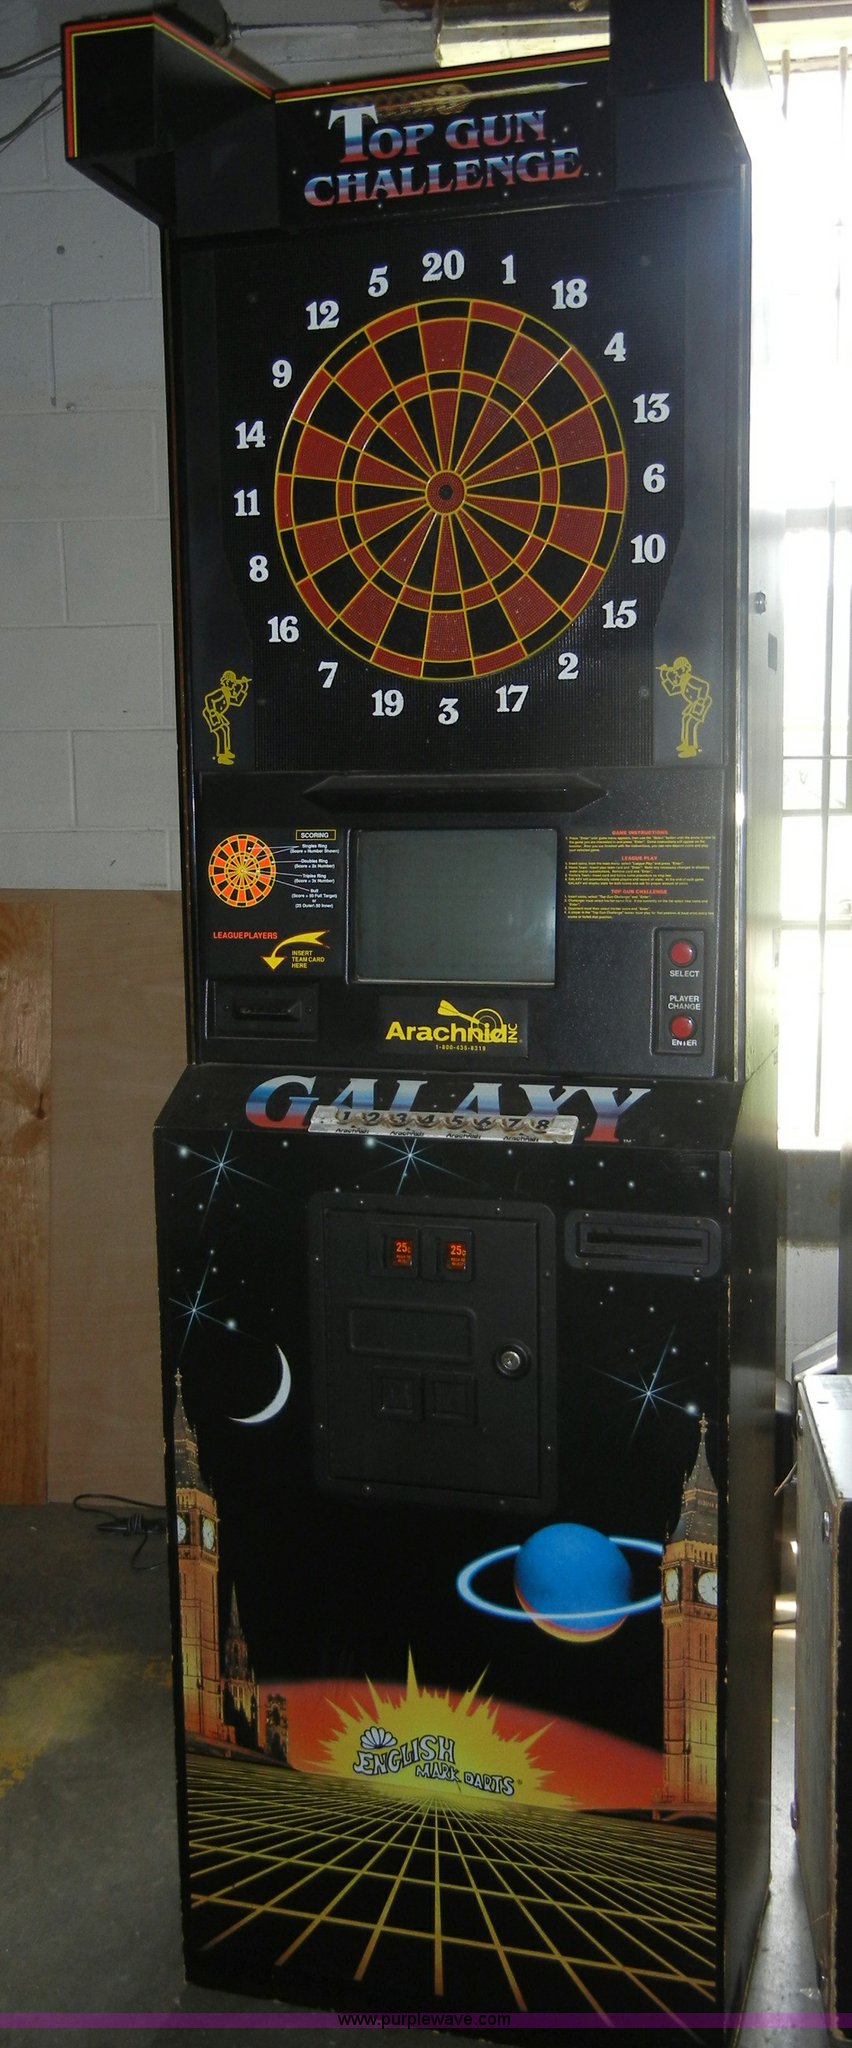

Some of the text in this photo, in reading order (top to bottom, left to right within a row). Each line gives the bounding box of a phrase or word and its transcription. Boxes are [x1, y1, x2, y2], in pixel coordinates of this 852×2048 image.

[328, 104, 546, 164] TOP GUN
[304, 147, 582, 208] CHALLENGE
[422, 250, 465, 282] 20
[502, 255, 516, 285] 1
[367, 265, 389, 298] 5
[551, 278, 588, 310] 18
[305, 300, 339, 330] 12
[604, 332, 626, 362] 4
[272, 360, 292, 388] 9
[633, 393, 670, 424] 13
[235, 421, 266, 449] 14
[643, 464, 666, 492] 6
[234, 489, 260, 516] 11
[630, 534, 666, 563] 10
[249, 556, 269, 582] 8
[602, 600, 637, 629] 15
[268, 616, 299, 643] 16
[318, 661, 338, 688] 7
[558, 653, 579, 680] 2
[372, 689, 404, 716] 19
[438, 697, 459, 725] 3
[496, 685, 528, 713] 17
[670, 970, 700, 978] SELECT
[385, 1021, 507, 1042] Arachnid
[508, 1023, 518, 1043] INC
[343, 1111, 549, 1129] 1 2 3 4 5 6 7 8
[353, 1734, 455, 1776] ENGLISH
[415, 1762, 515, 1796] MARK DARTS
